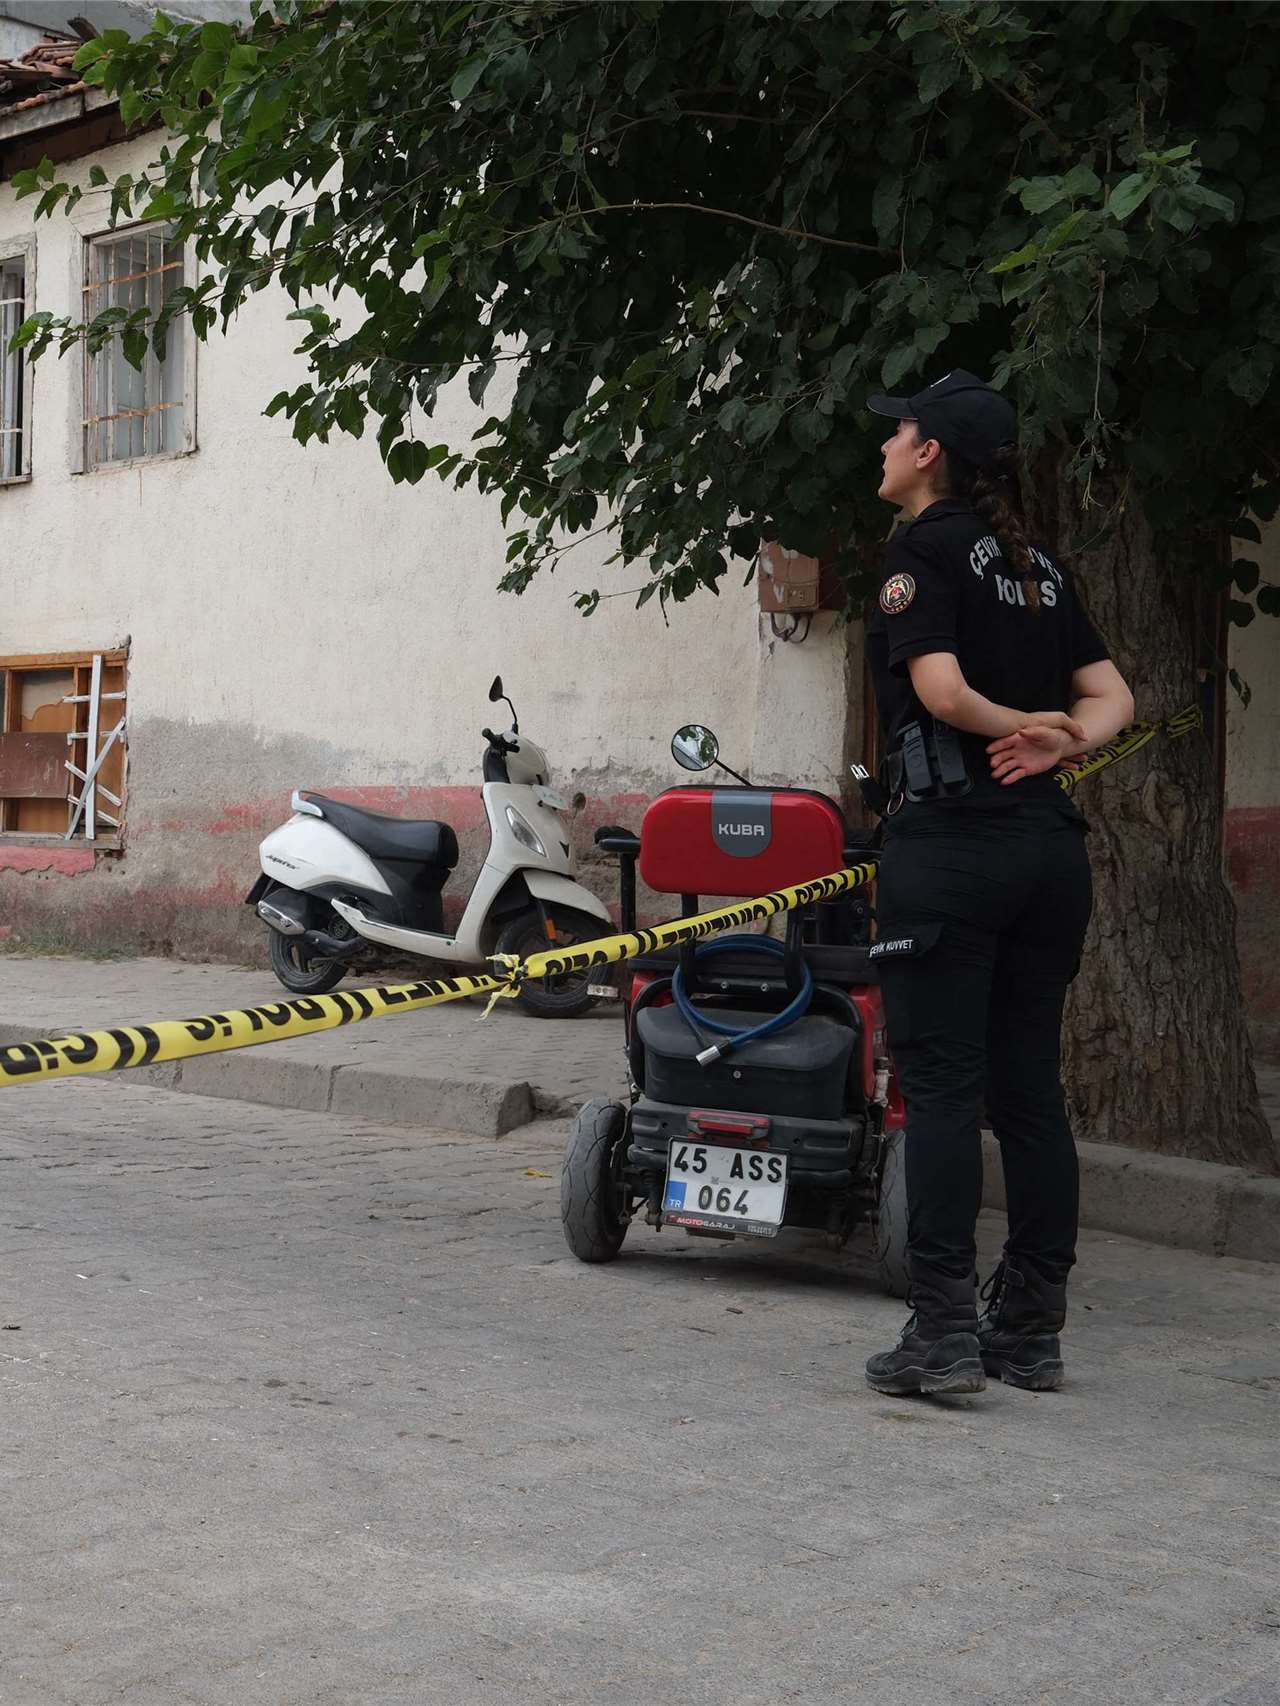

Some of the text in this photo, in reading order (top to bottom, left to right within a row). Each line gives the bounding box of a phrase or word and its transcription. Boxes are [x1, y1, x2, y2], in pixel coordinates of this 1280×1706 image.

[969, 536, 1001, 580] ÇEVİK
[995, 574, 1057, 607] POLS
[718, 823, 765, 836] KUBA
[886, 939, 913, 951] KUVVET
[674, 1146, 782, 1183] 45 ASS
[669, 1199, 682, 1208] TR
[698, 1185, 749, 1215] 064
